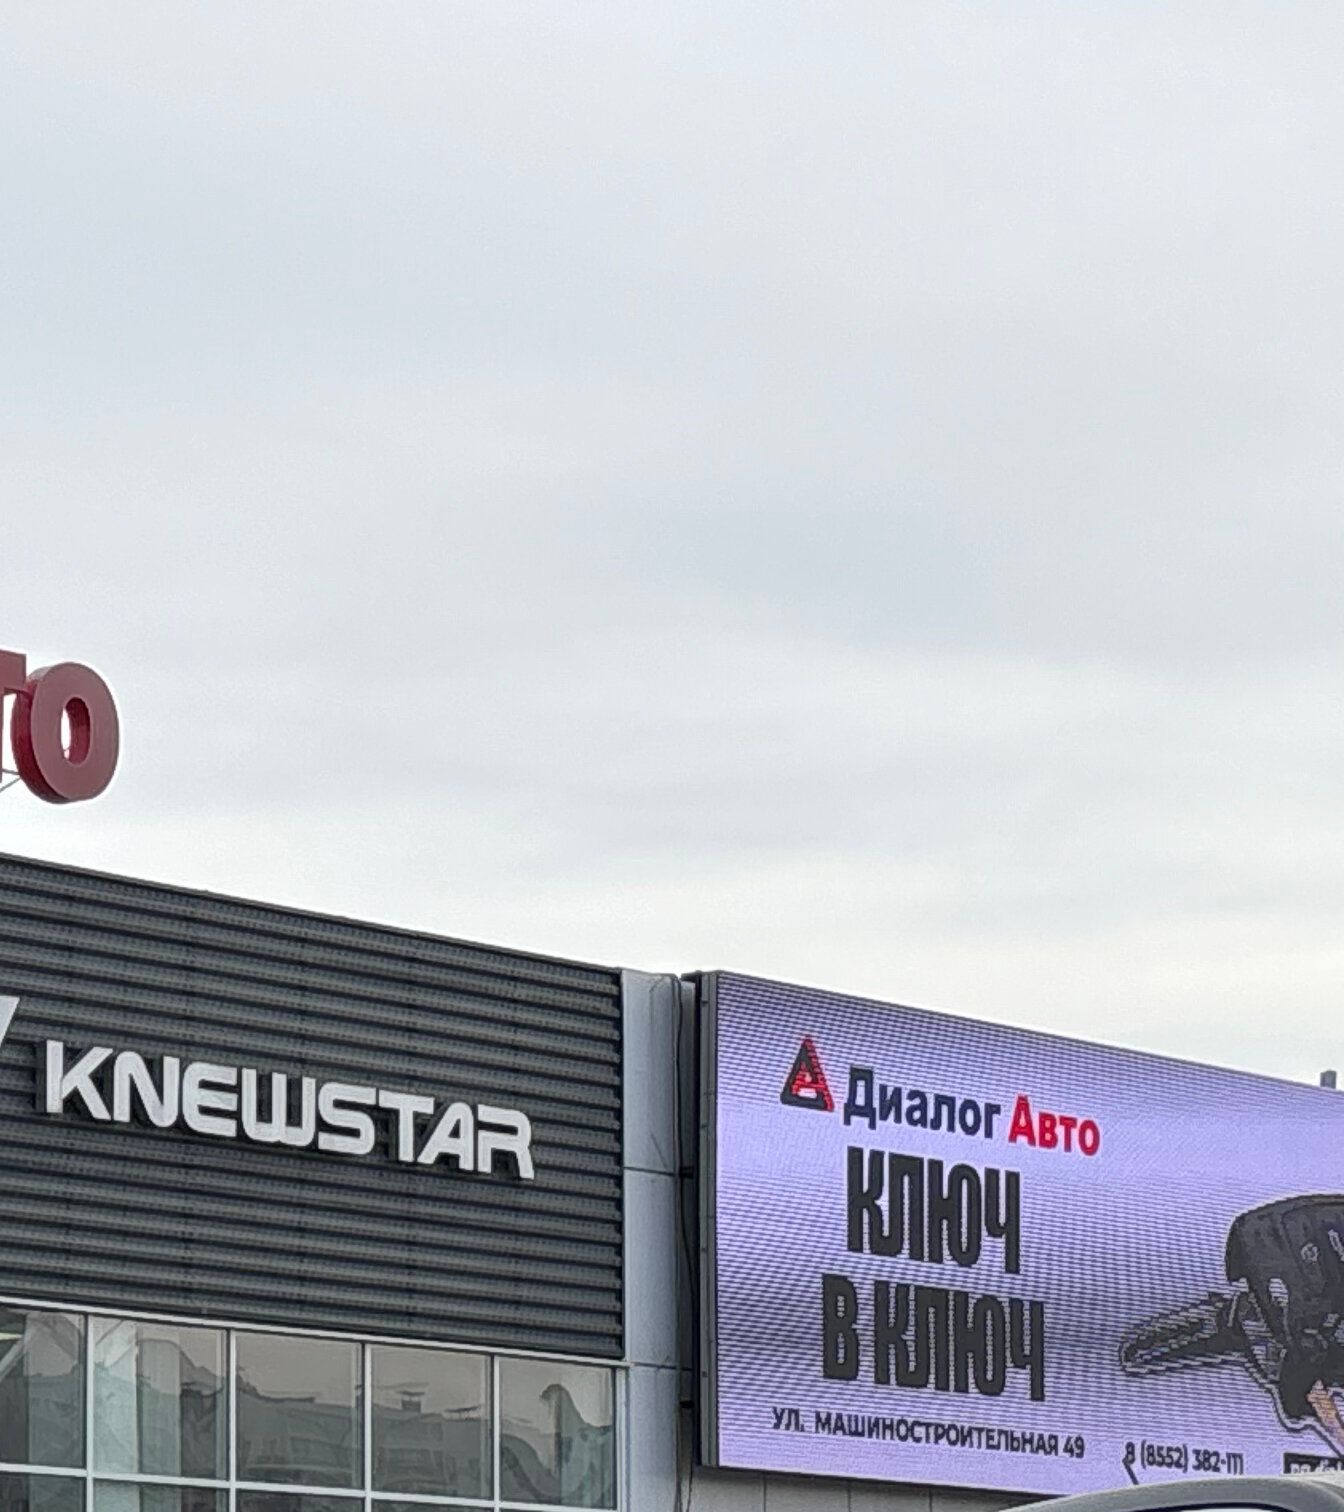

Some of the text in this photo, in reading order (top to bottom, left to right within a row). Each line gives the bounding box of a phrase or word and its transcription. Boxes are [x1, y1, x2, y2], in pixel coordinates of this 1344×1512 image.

[44, 1039, 535, 1180] KNEWSTAR
[843, 1064, 1100, 1156] Диалог Авто
[846, 1146, 1020, 1273] КЛЮЧ
[873, 1280, 1045, 1401] КЛЮЧ
[772, 1407, 1085, 1458] УЛ. МАШИНОСТРОИТЕЛЬНАЯ 49
[1140, 1439, 1188, 1473] (8552)
